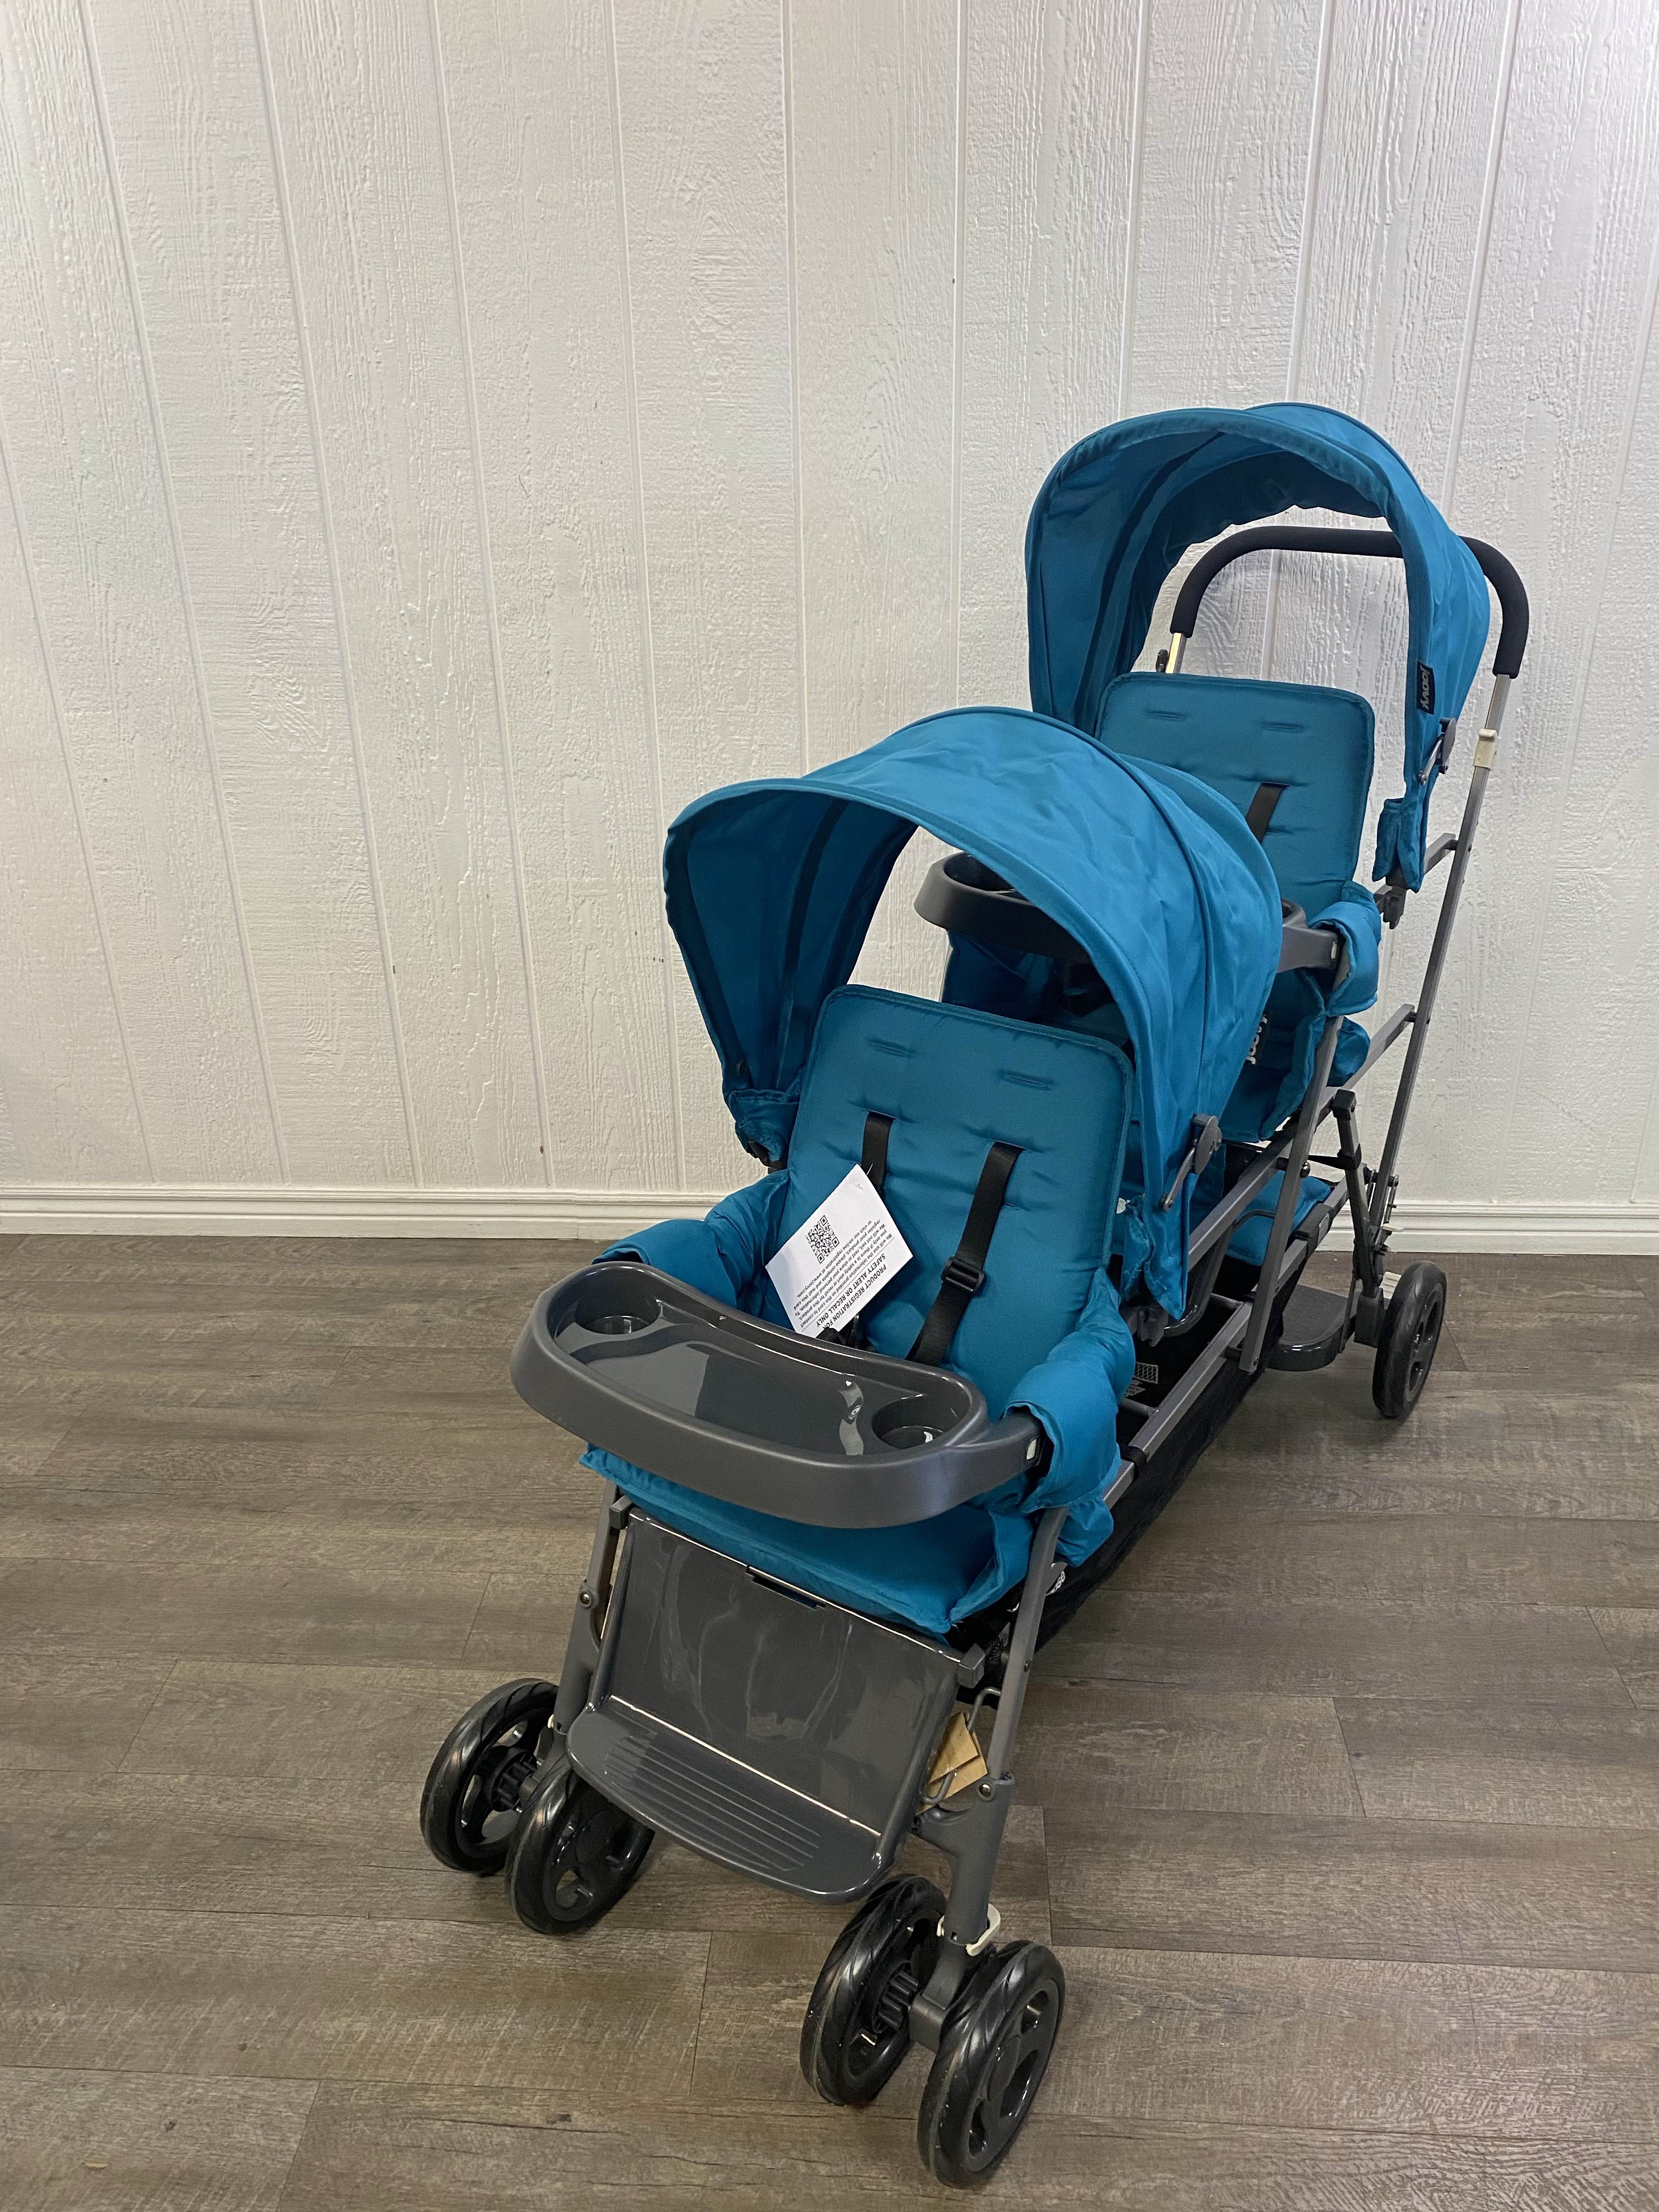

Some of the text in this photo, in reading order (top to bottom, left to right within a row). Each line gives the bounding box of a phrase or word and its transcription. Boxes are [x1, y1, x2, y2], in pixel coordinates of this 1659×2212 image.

[816, 1253, 886, 1328] SAFETY ALERT OR RECALL ONLY
[865, 1263, 887, 1289] PRODUCT
[832, 1286, 865, 1322] REGISTRATION
